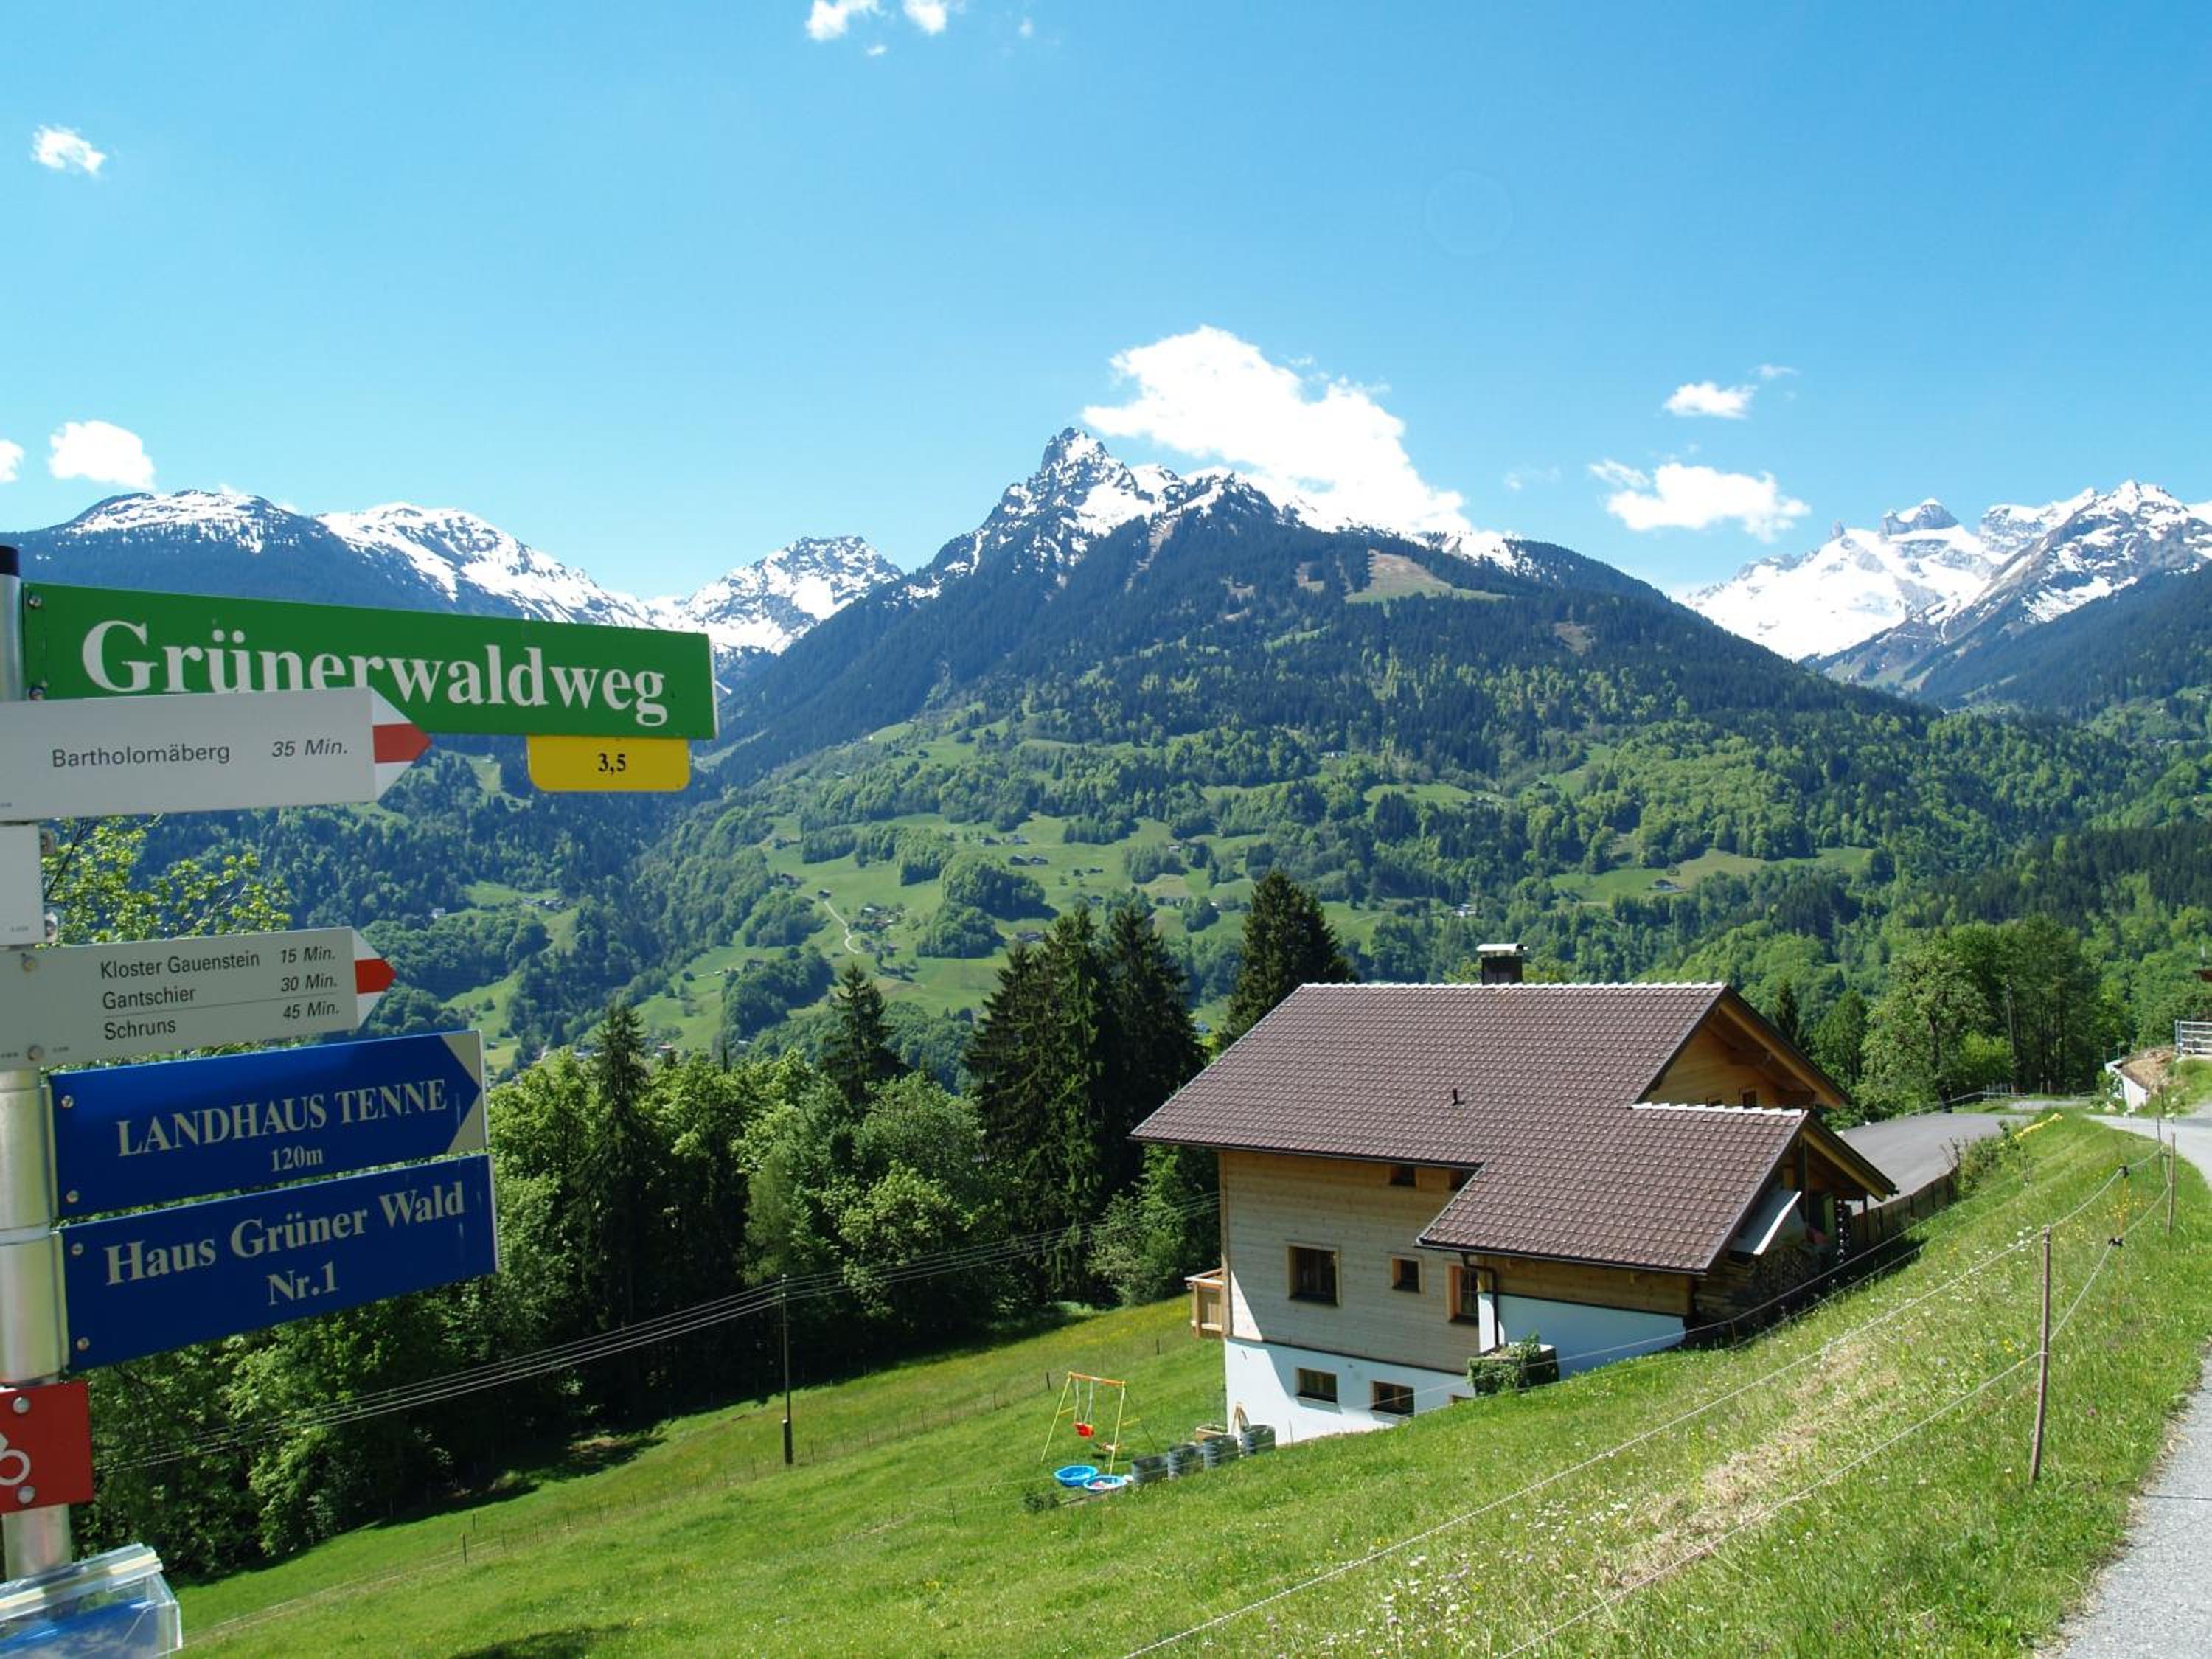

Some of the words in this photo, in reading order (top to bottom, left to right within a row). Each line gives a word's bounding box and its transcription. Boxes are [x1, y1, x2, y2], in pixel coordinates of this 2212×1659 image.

[82, 620, 668, 727] Grünerwaldweg
[52, 743, 231, 768] Bartholomäberg
[271, 740, 296, 758] 35
[304, 738, 349, 757] Min.
[598, 753, 627, 775] 3,5
[100, 959, 162, 980] Kloster
[167, 950, 260, 975] Gauenstein
[280, 948, 297, 964] 15
[304, 946, 335, 963] Min.
[102, 985, 197, 1011] Gantschier
[280, 977, 299, 992] 30
[305, 973, 338, 990] Min.
[105, 1019, 177, 1041] Schruns
[283, 1004, 301, 1020] 45
[307, 1001, 340, 1018] Min.
[116, 1093, 327, 1157] LANDHAUS
[334, 1079, 447, 1124] TENNE
[270, 1145, 324, 1172] 120m
[105, 1238, 216, 1286] Haus
[230, 1208, 369, 1259] Grüner
[379, 1180, 465, 1228] Wald
[267, 1261, 340, 1307] Nr.1
